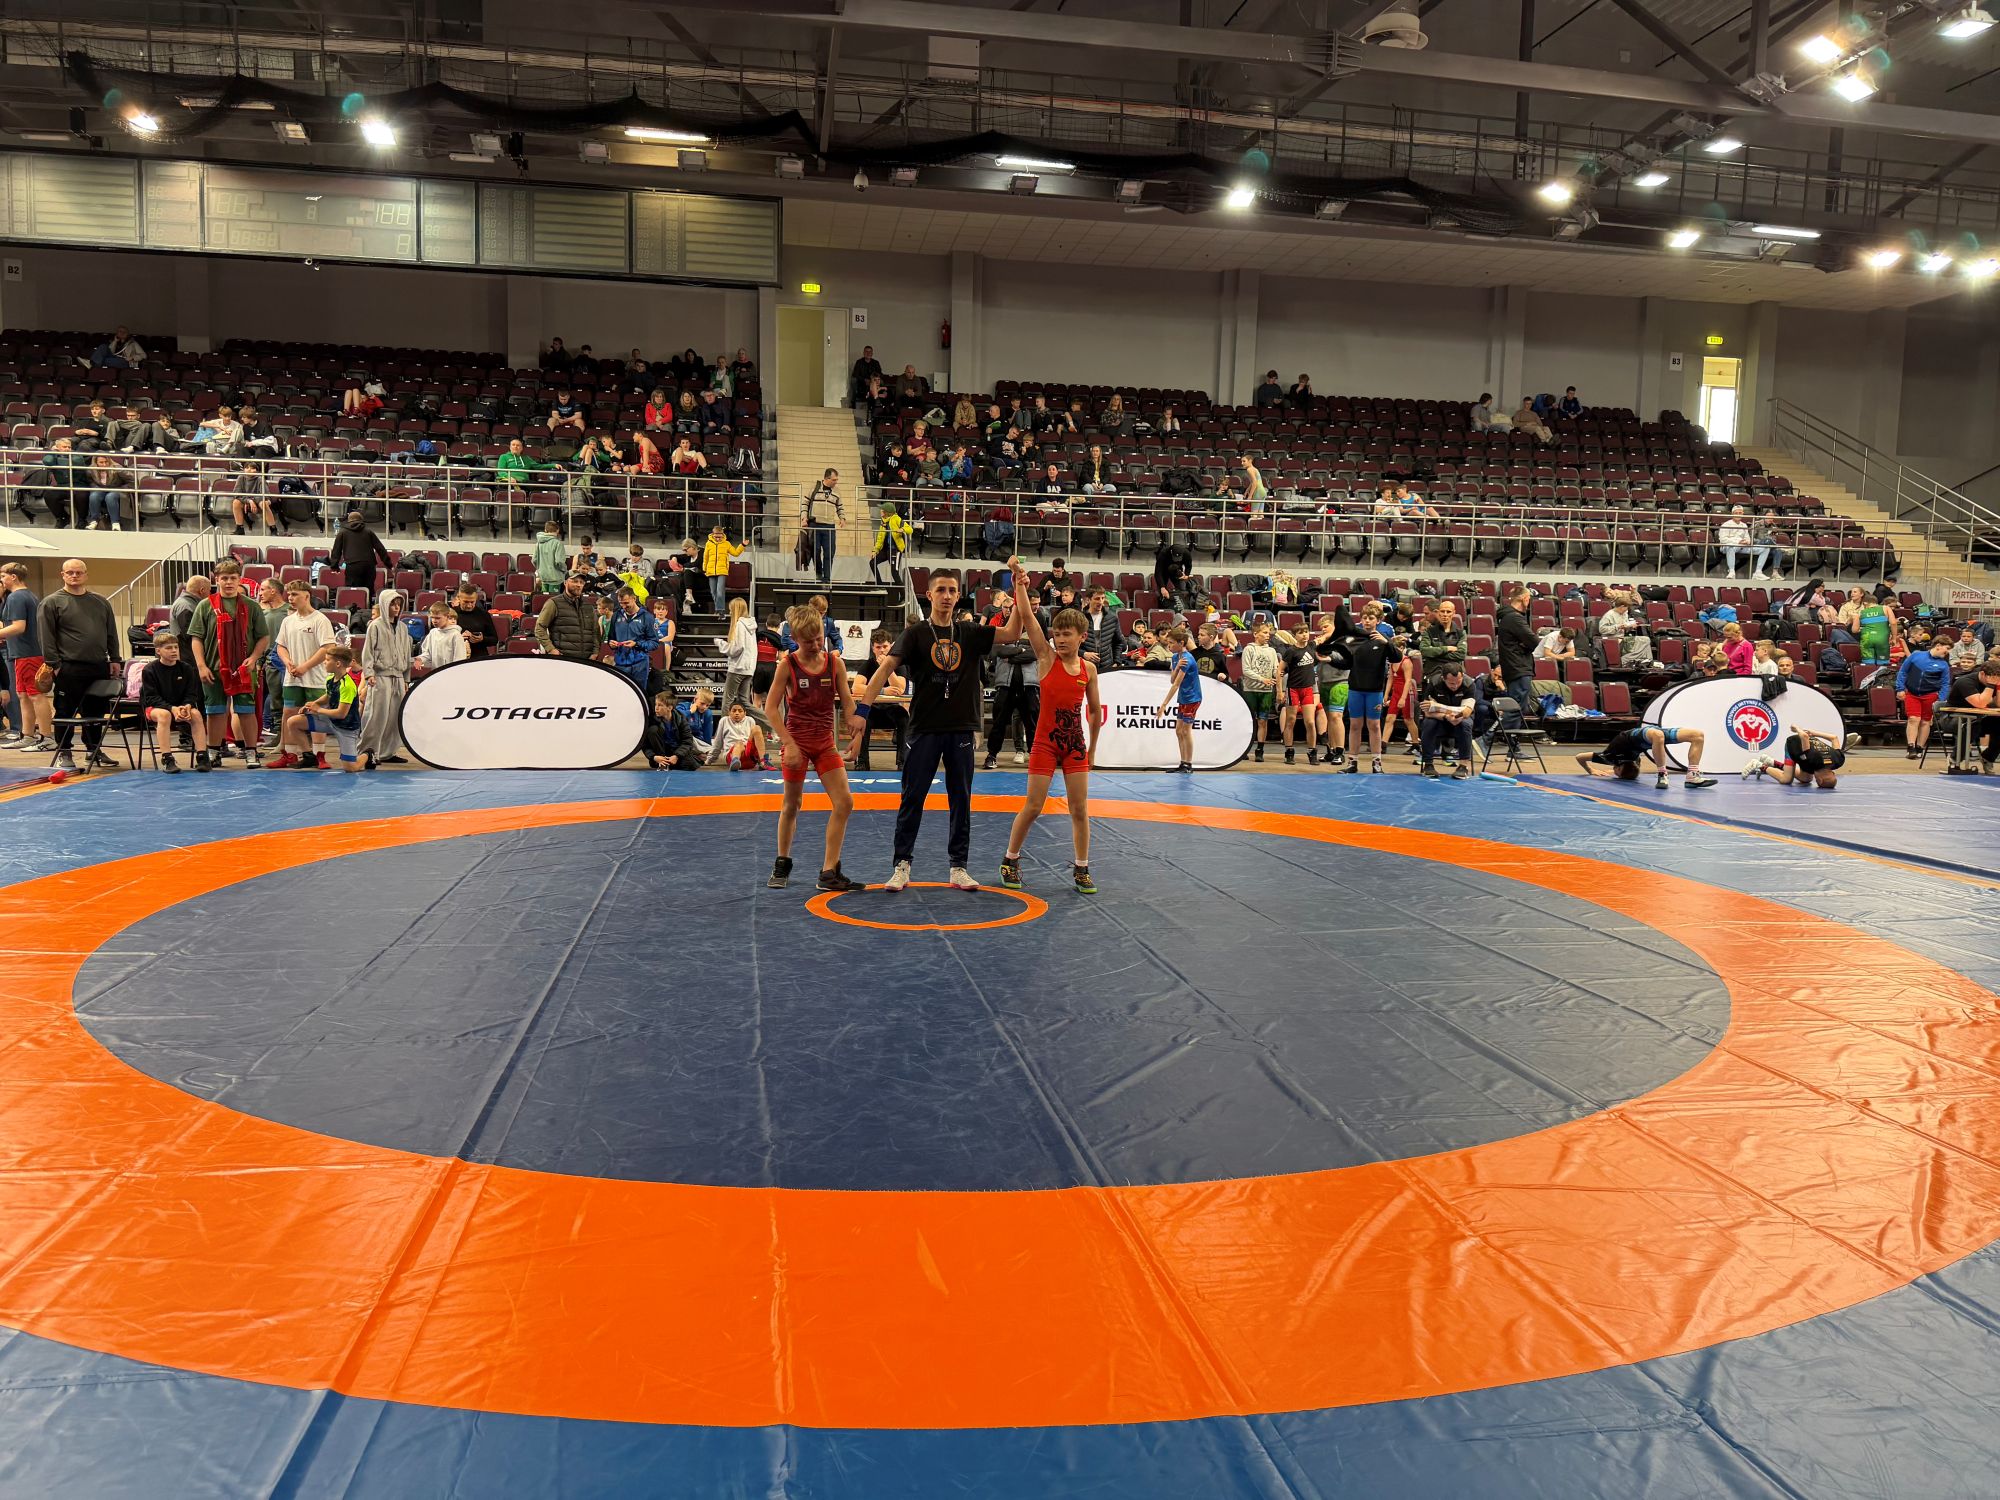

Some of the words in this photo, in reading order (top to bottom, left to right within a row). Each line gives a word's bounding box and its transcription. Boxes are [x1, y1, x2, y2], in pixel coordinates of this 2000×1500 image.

[7, 265, 20, 275] B2
[855, 314, 865, 323] B3
[442, 706, 608, 720] JOTAGRIS
[1116, 705, 1179, 717] LIETUVO
[1116, 718, 1223, 731] KARIUOENĖ
